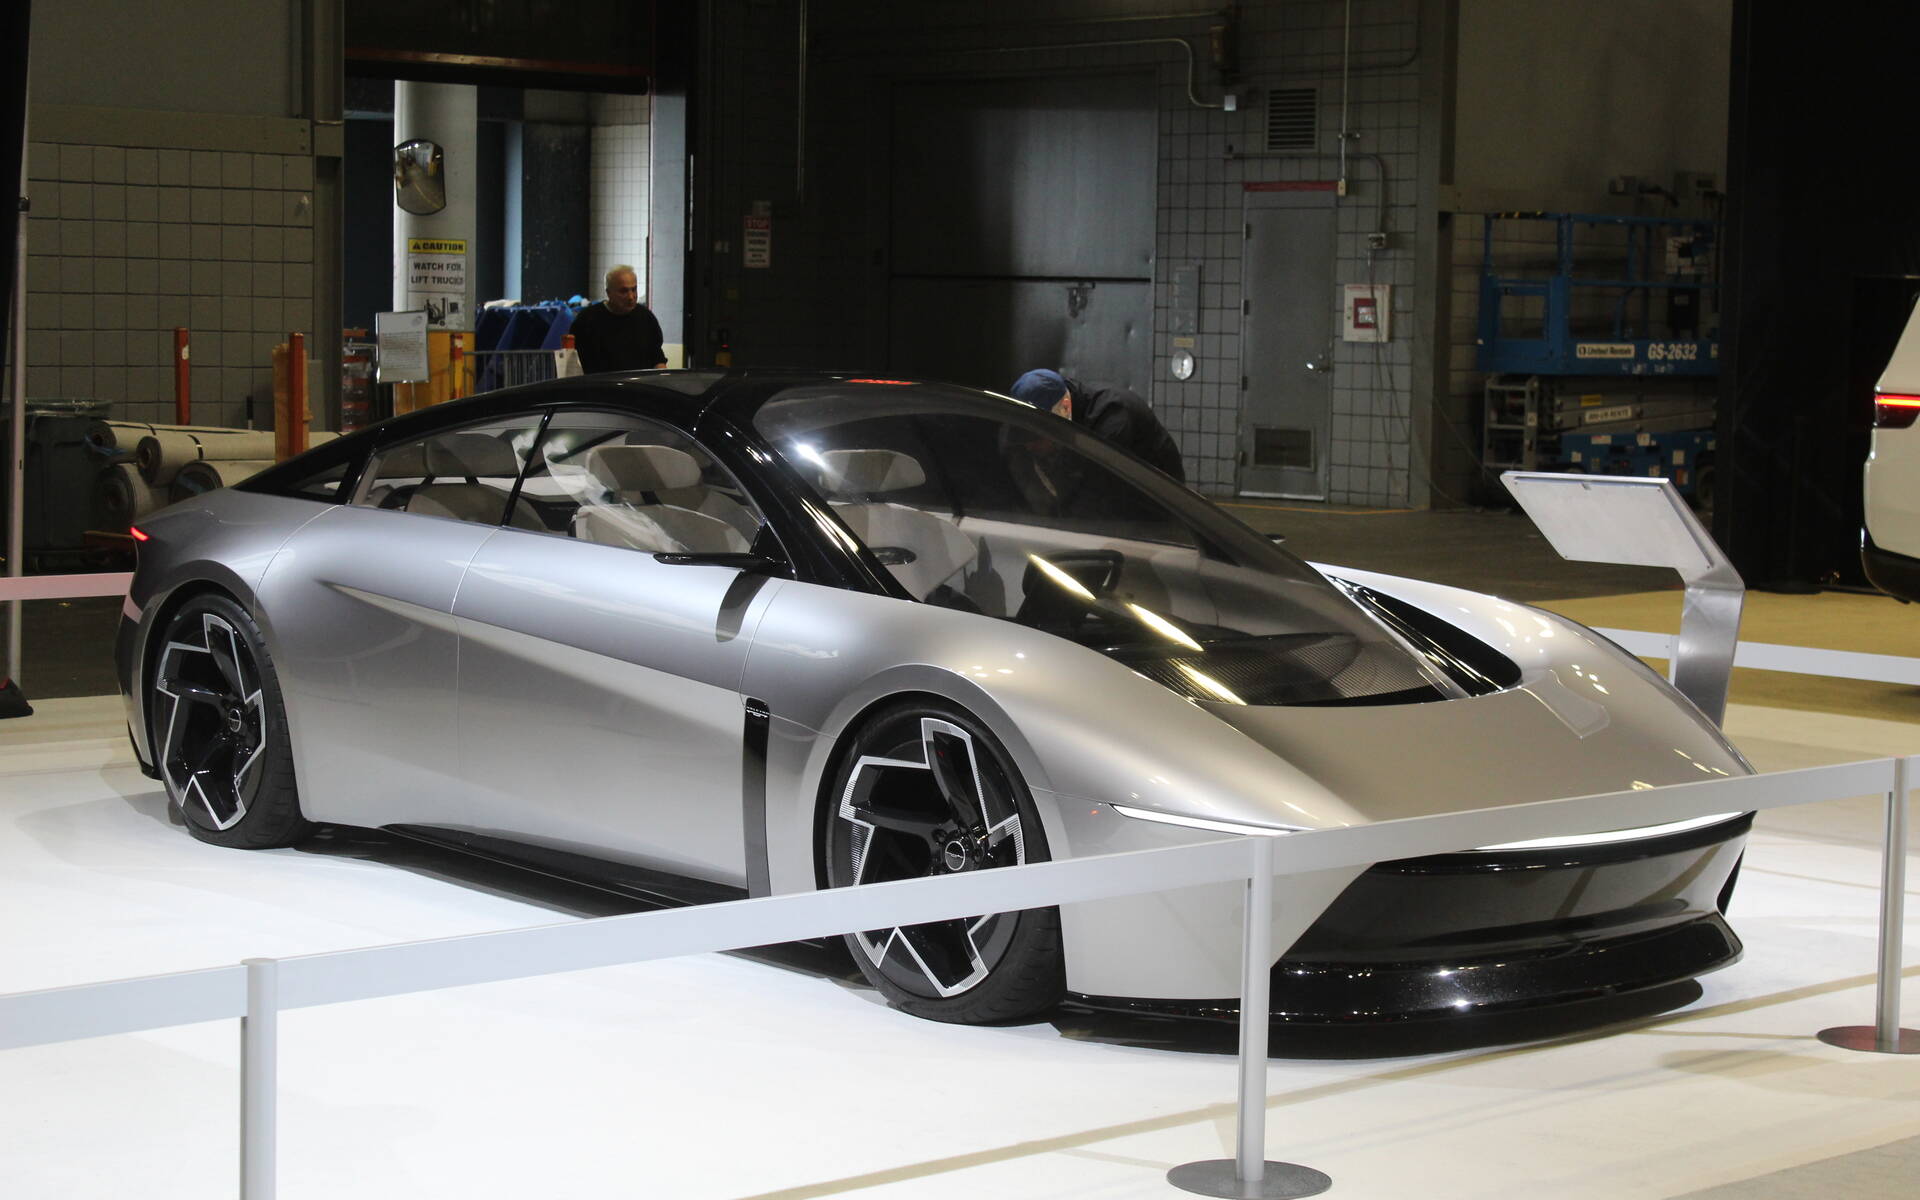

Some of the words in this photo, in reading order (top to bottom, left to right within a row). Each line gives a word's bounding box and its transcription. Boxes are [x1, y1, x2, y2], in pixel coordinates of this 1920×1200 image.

[422, 242, 464, 251] CAUTION
[413, 262, 444, 271] WATCH
[411, 276, 428, 284] LIFT
[432, 276, 464, 285] TRUCKS
[1648, 342, 1698, 360] GS-2632
